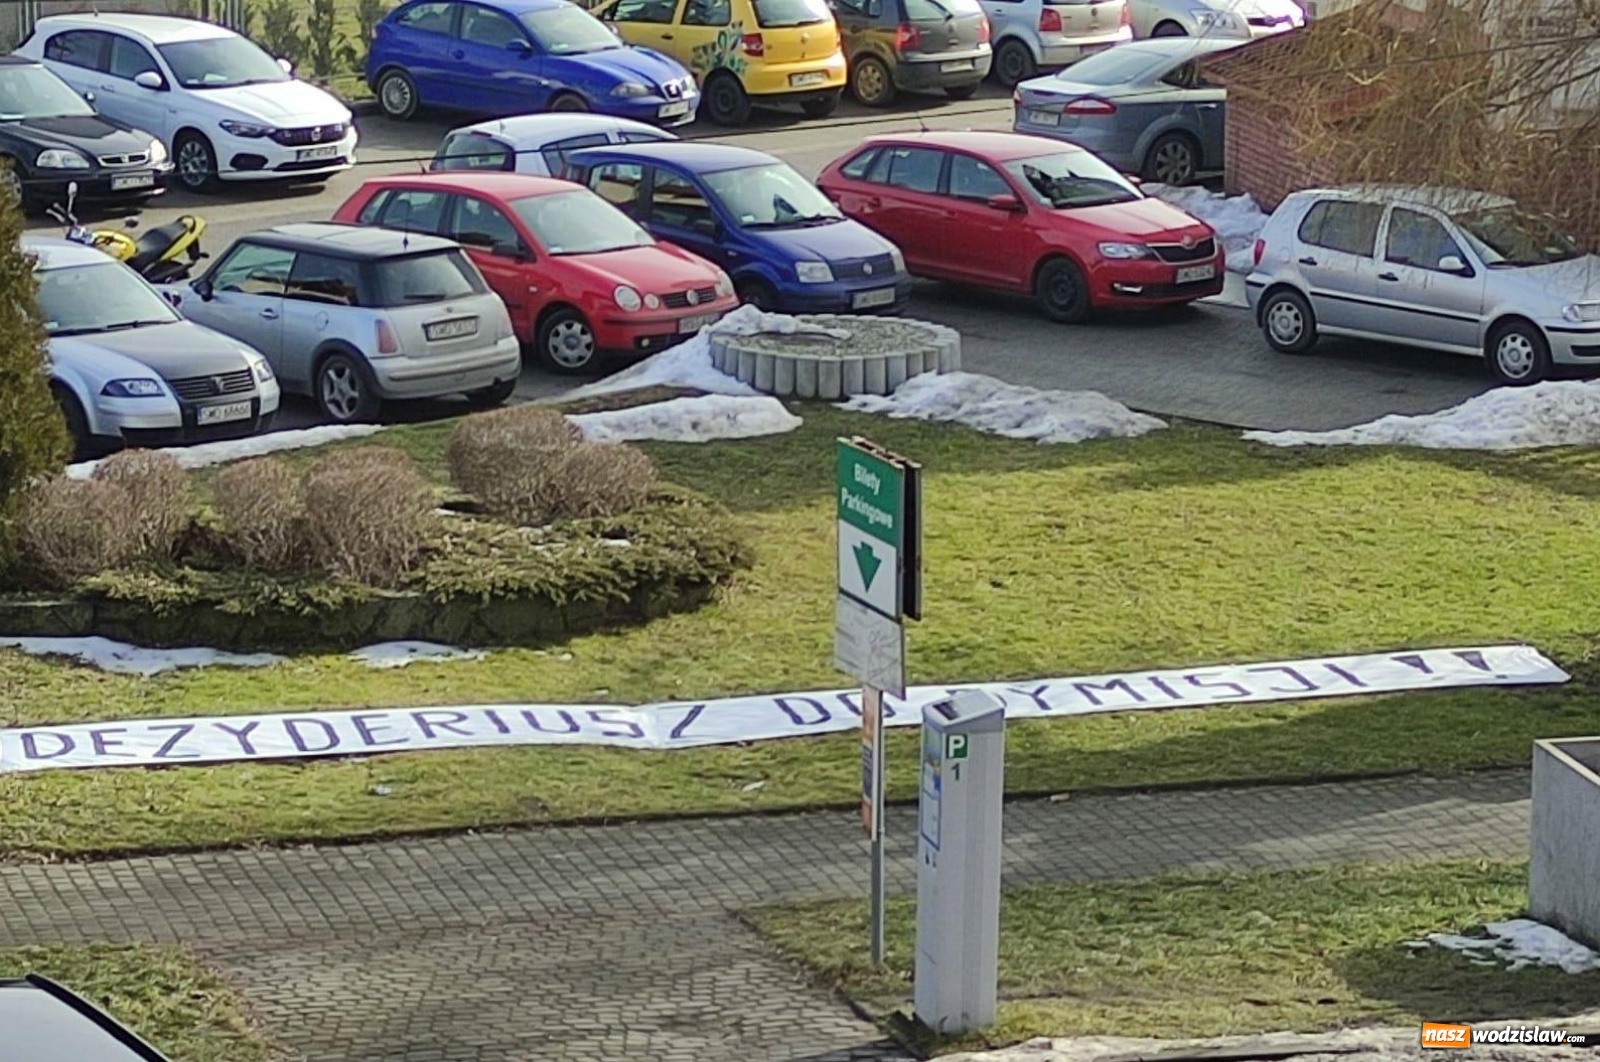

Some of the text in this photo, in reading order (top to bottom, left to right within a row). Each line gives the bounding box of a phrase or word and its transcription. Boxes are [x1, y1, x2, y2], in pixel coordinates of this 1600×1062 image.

[854, 463, 881, 496] Bilety
[841, 487, 893, 529] Parkingowe
[20, 704, 706, 760] DEZYDERIUSZ
[946, 663, 1369, 710] YMISJI
[949, 735, 966, 758] P
[951, 763, 960, 782] 1
